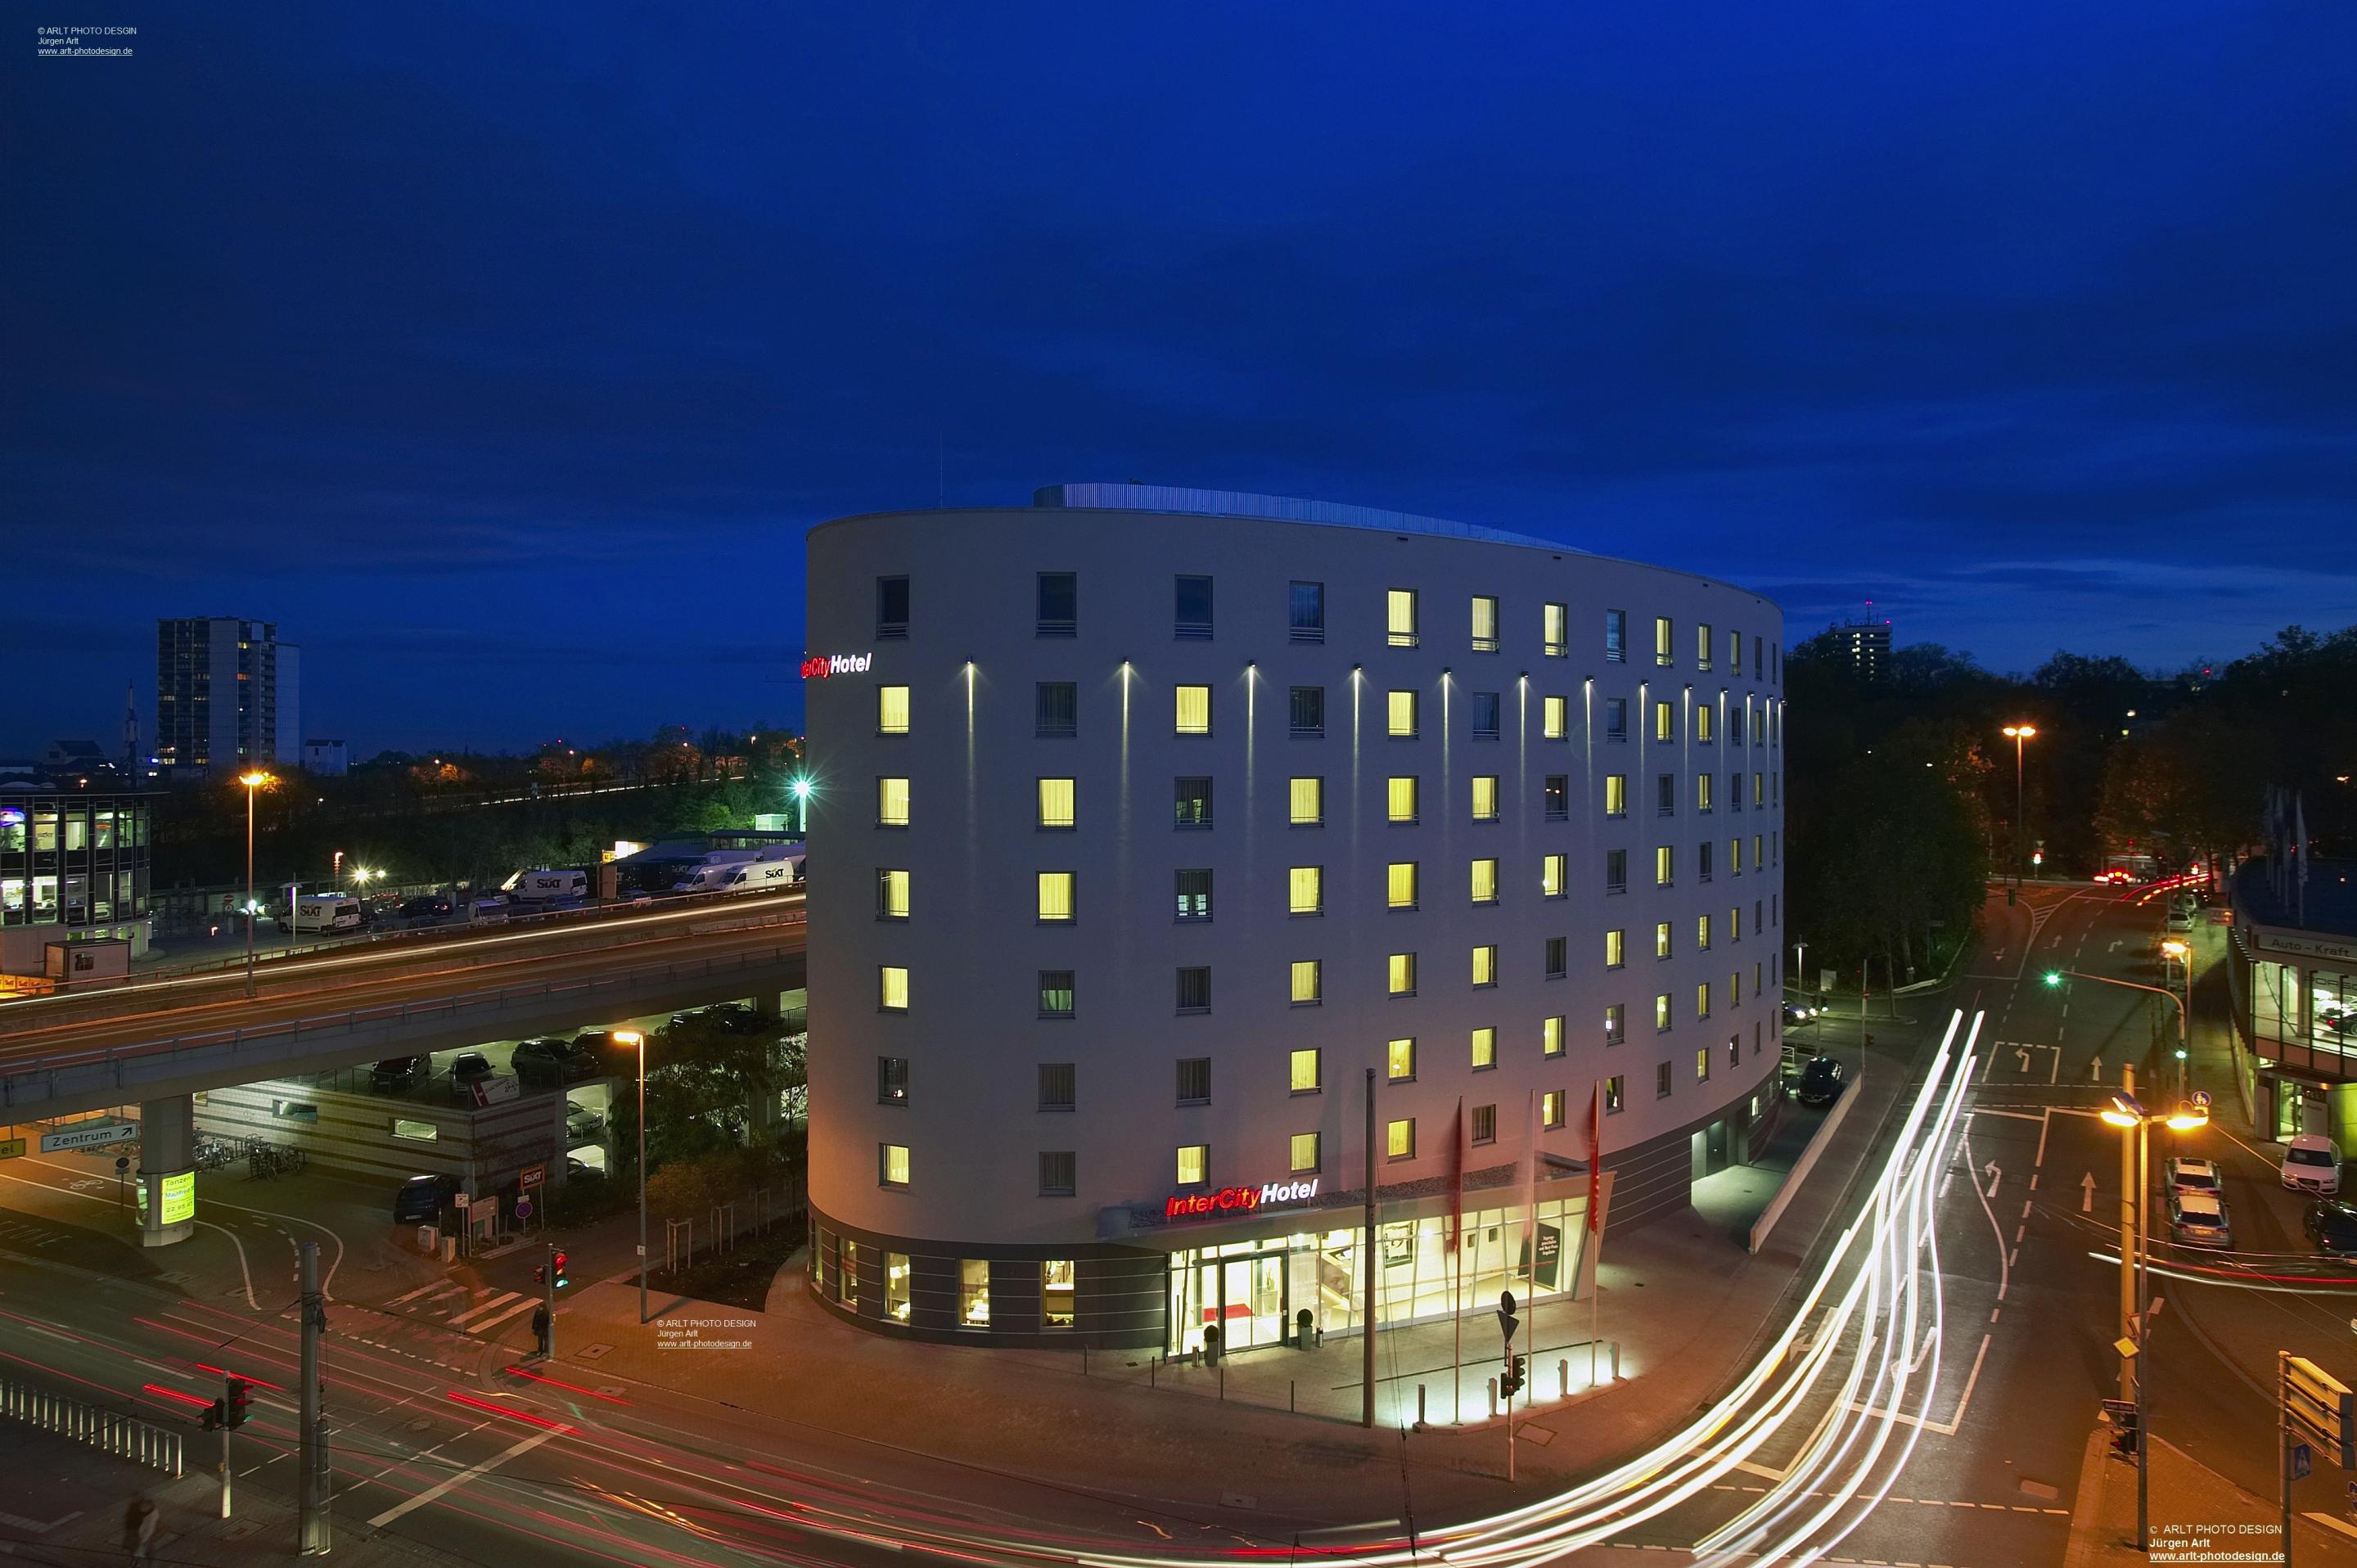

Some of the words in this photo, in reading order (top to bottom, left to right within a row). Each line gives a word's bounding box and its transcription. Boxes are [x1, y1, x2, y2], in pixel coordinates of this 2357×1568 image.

[2272, 939, 2301, 951] Auto
[2315, 944, 2350, 957] Kraft
[52, 1131, 111, 1147] Zentrum
[1165, 1178, 1318, 1217] InterCityHotel
